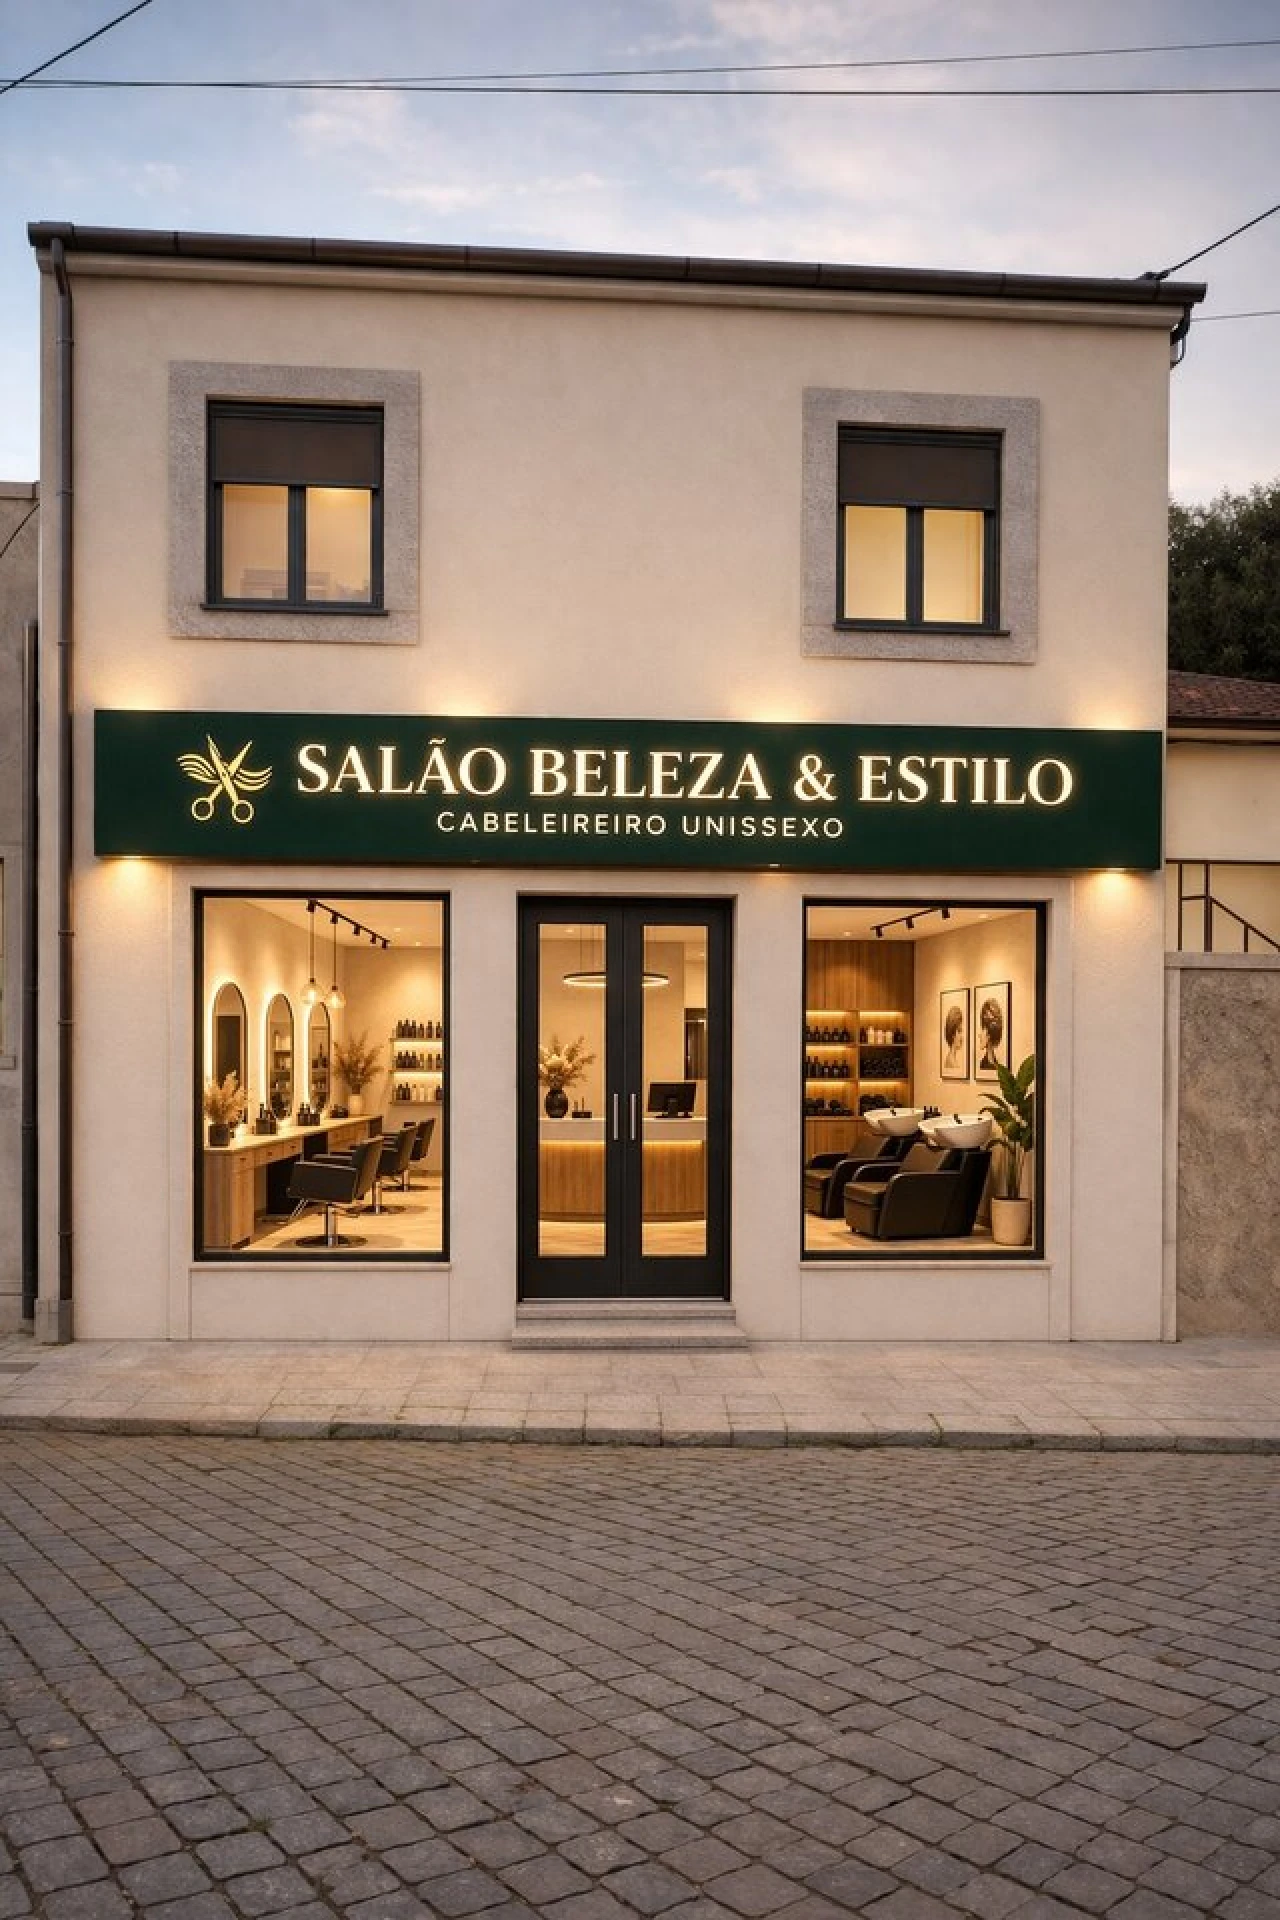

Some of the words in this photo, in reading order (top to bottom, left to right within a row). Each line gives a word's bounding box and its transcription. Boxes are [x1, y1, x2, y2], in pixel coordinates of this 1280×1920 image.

[297, 737, 507, 797] SALÃO
[529, 749, 773, 801] BELEZA
[793, 753, 838, 802] &
[858, 755, 1074, 806] ESTILO
[437, 811, 668, 836] CABELEIREIRO
[682, 815, 844, 839] UNISSEXO
